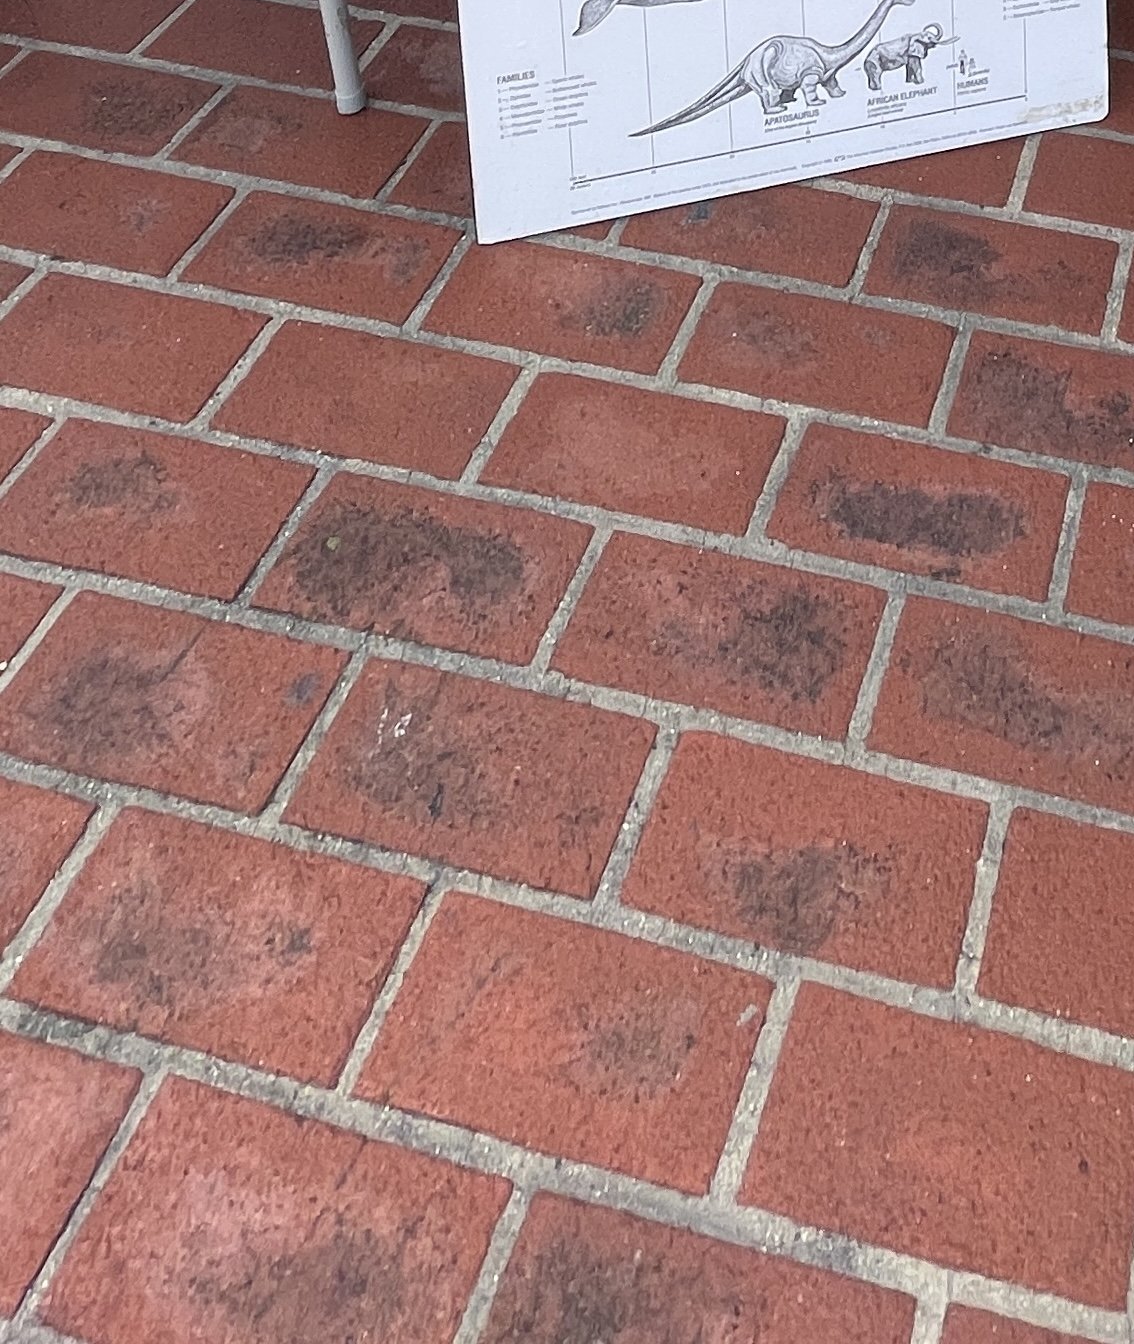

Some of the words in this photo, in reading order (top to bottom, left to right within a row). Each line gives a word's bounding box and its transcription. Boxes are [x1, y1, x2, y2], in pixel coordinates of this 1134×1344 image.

[496, 70, 536, 86] FAMILIES
[866, 93, 900, 108] AFRICAN
[900, 86, 938, 101] ELEPHANT
[764, 108, 821, 127] APATOSAURUS
